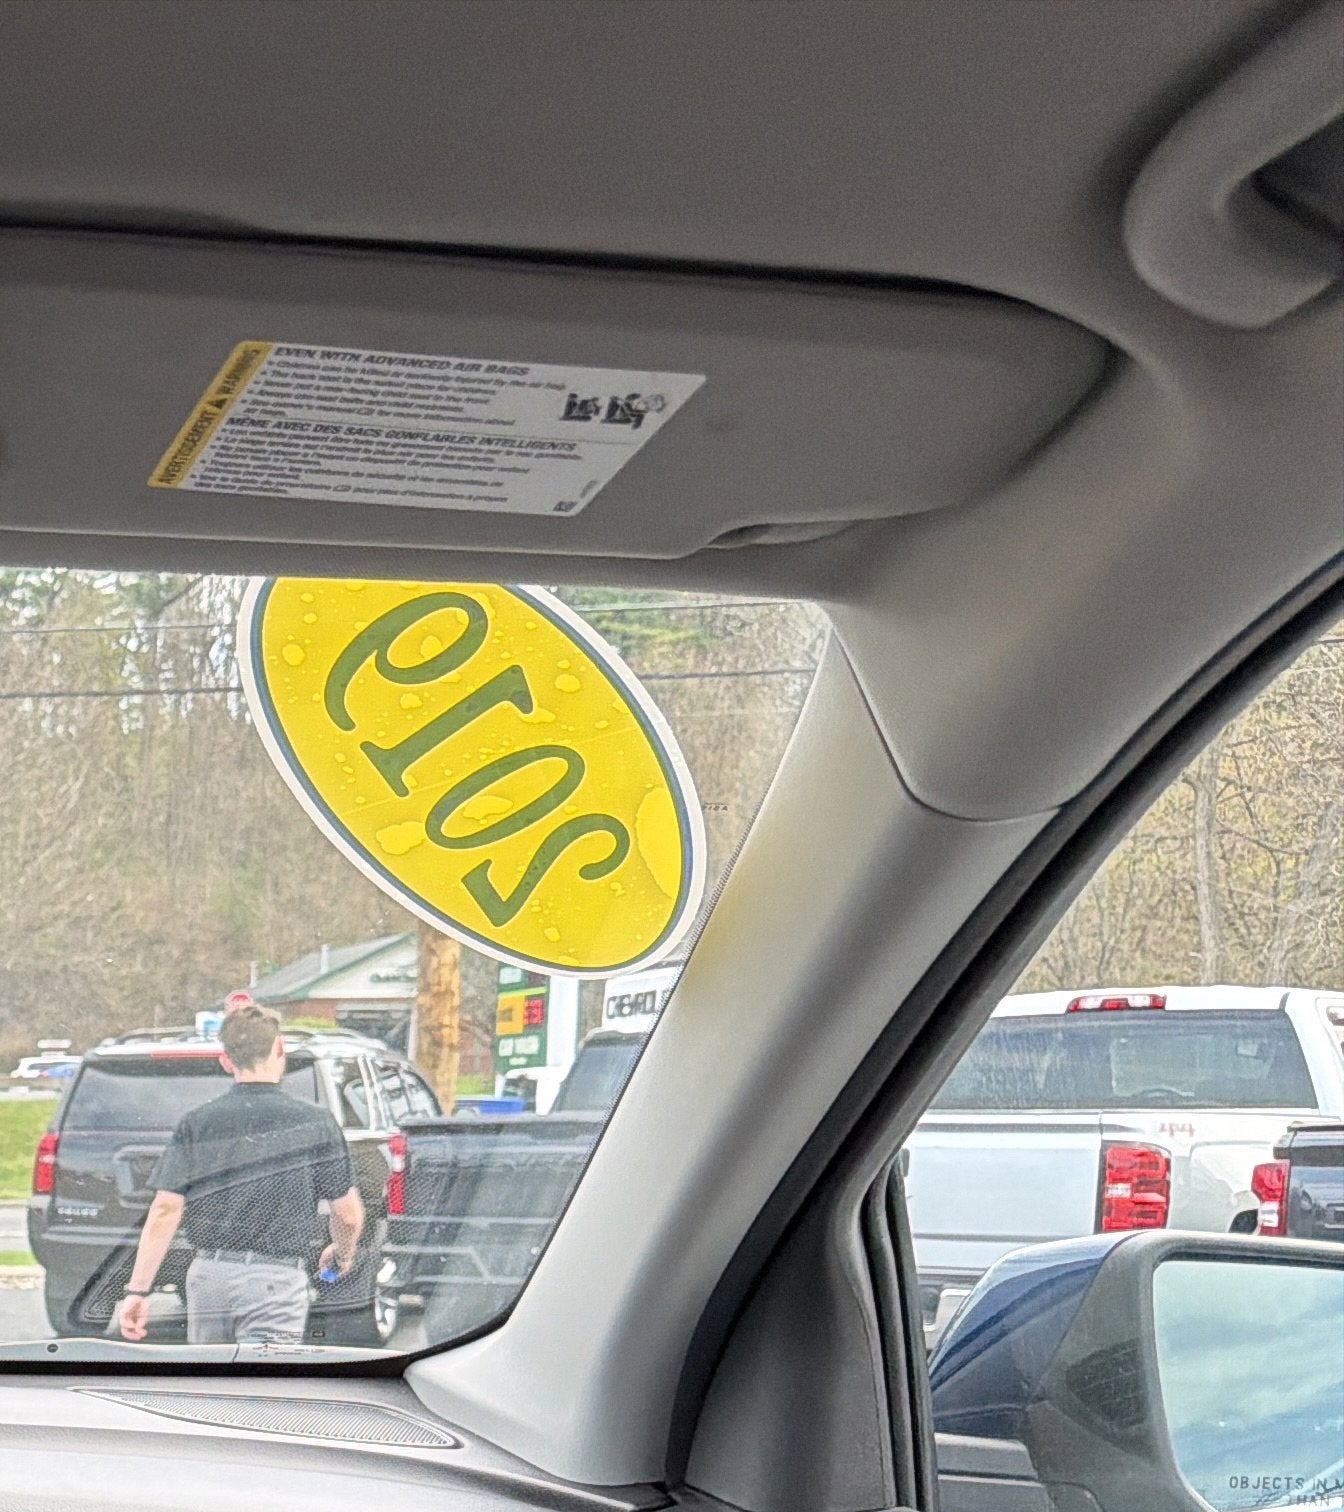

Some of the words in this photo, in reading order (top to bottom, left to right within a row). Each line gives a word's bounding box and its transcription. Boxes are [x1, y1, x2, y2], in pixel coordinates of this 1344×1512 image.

[274, 347, 316, 358] EVEN
[320, 351, 362, 362] WITH
[363, 354, 451, 370] ADVANCED
[453, 363, 482, 372] AIR
[484, 366, 530, 376] BAGS
[226, 416, 269, 428] MÊME
[273, 420, 311, 432] AVEC
[312, 424, 343, 434] DES
[344, 427, 382, 438] SACS
[384, 430, 476, 445] GONFLABLES
[478, 436, 576, 451] INTELLIGENTS
[1229, 1476, 1305, 1490] OBJECTS
[1313, 1479, 1327, 1490] IN
